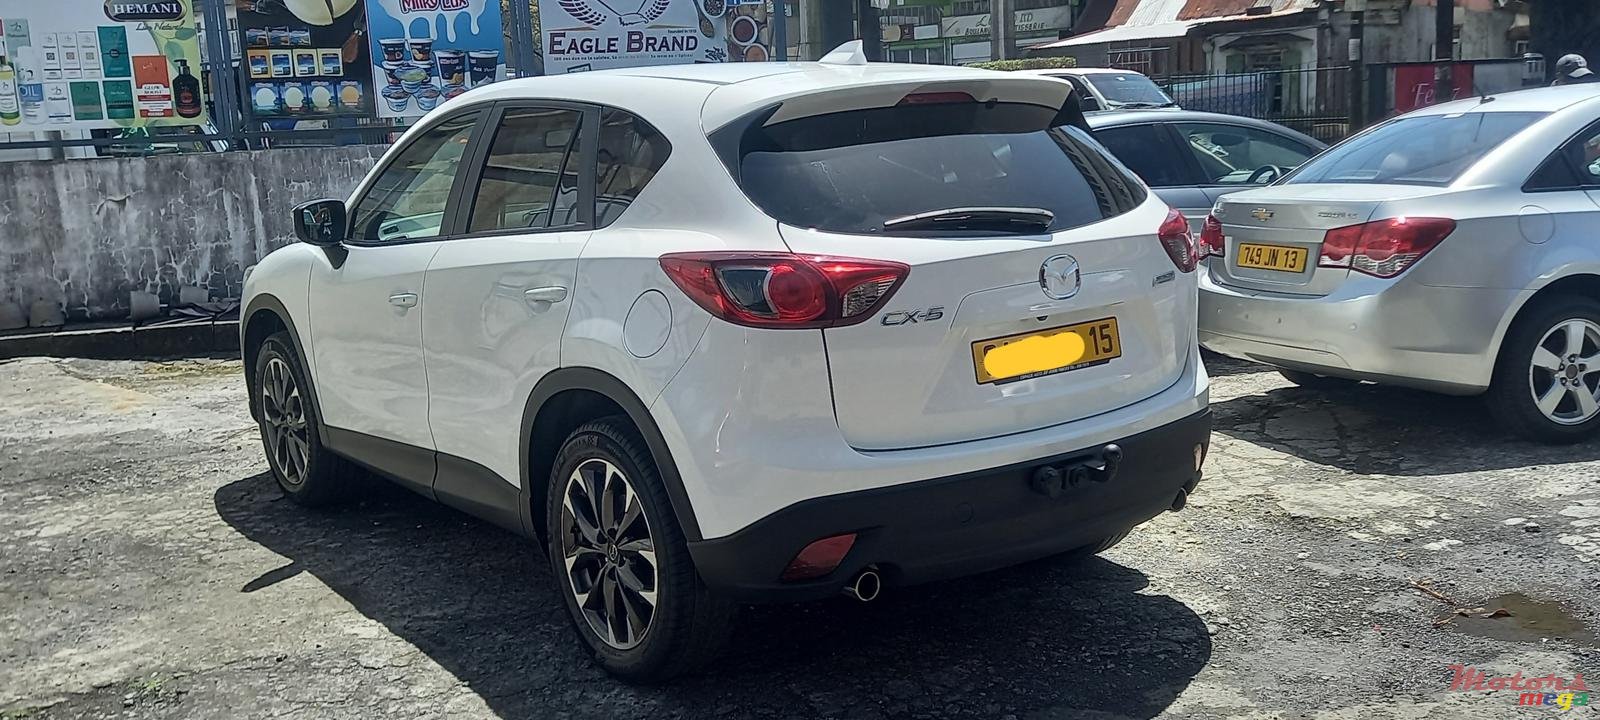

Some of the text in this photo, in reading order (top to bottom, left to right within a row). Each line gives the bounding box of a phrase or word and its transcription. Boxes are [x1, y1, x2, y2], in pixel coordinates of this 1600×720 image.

[114, 3, 178, 14] HEMANI
[401, 0, 438, 13] Milky
[549, 31, 699, 55] EAGLE BRAND
[18, 85, 39, 97] OIL
[1244, 247, 1297, 269] 749 JN 13
[880, 306, 945, 326] CX-5
[1088, 323, 1114, 356] 15
